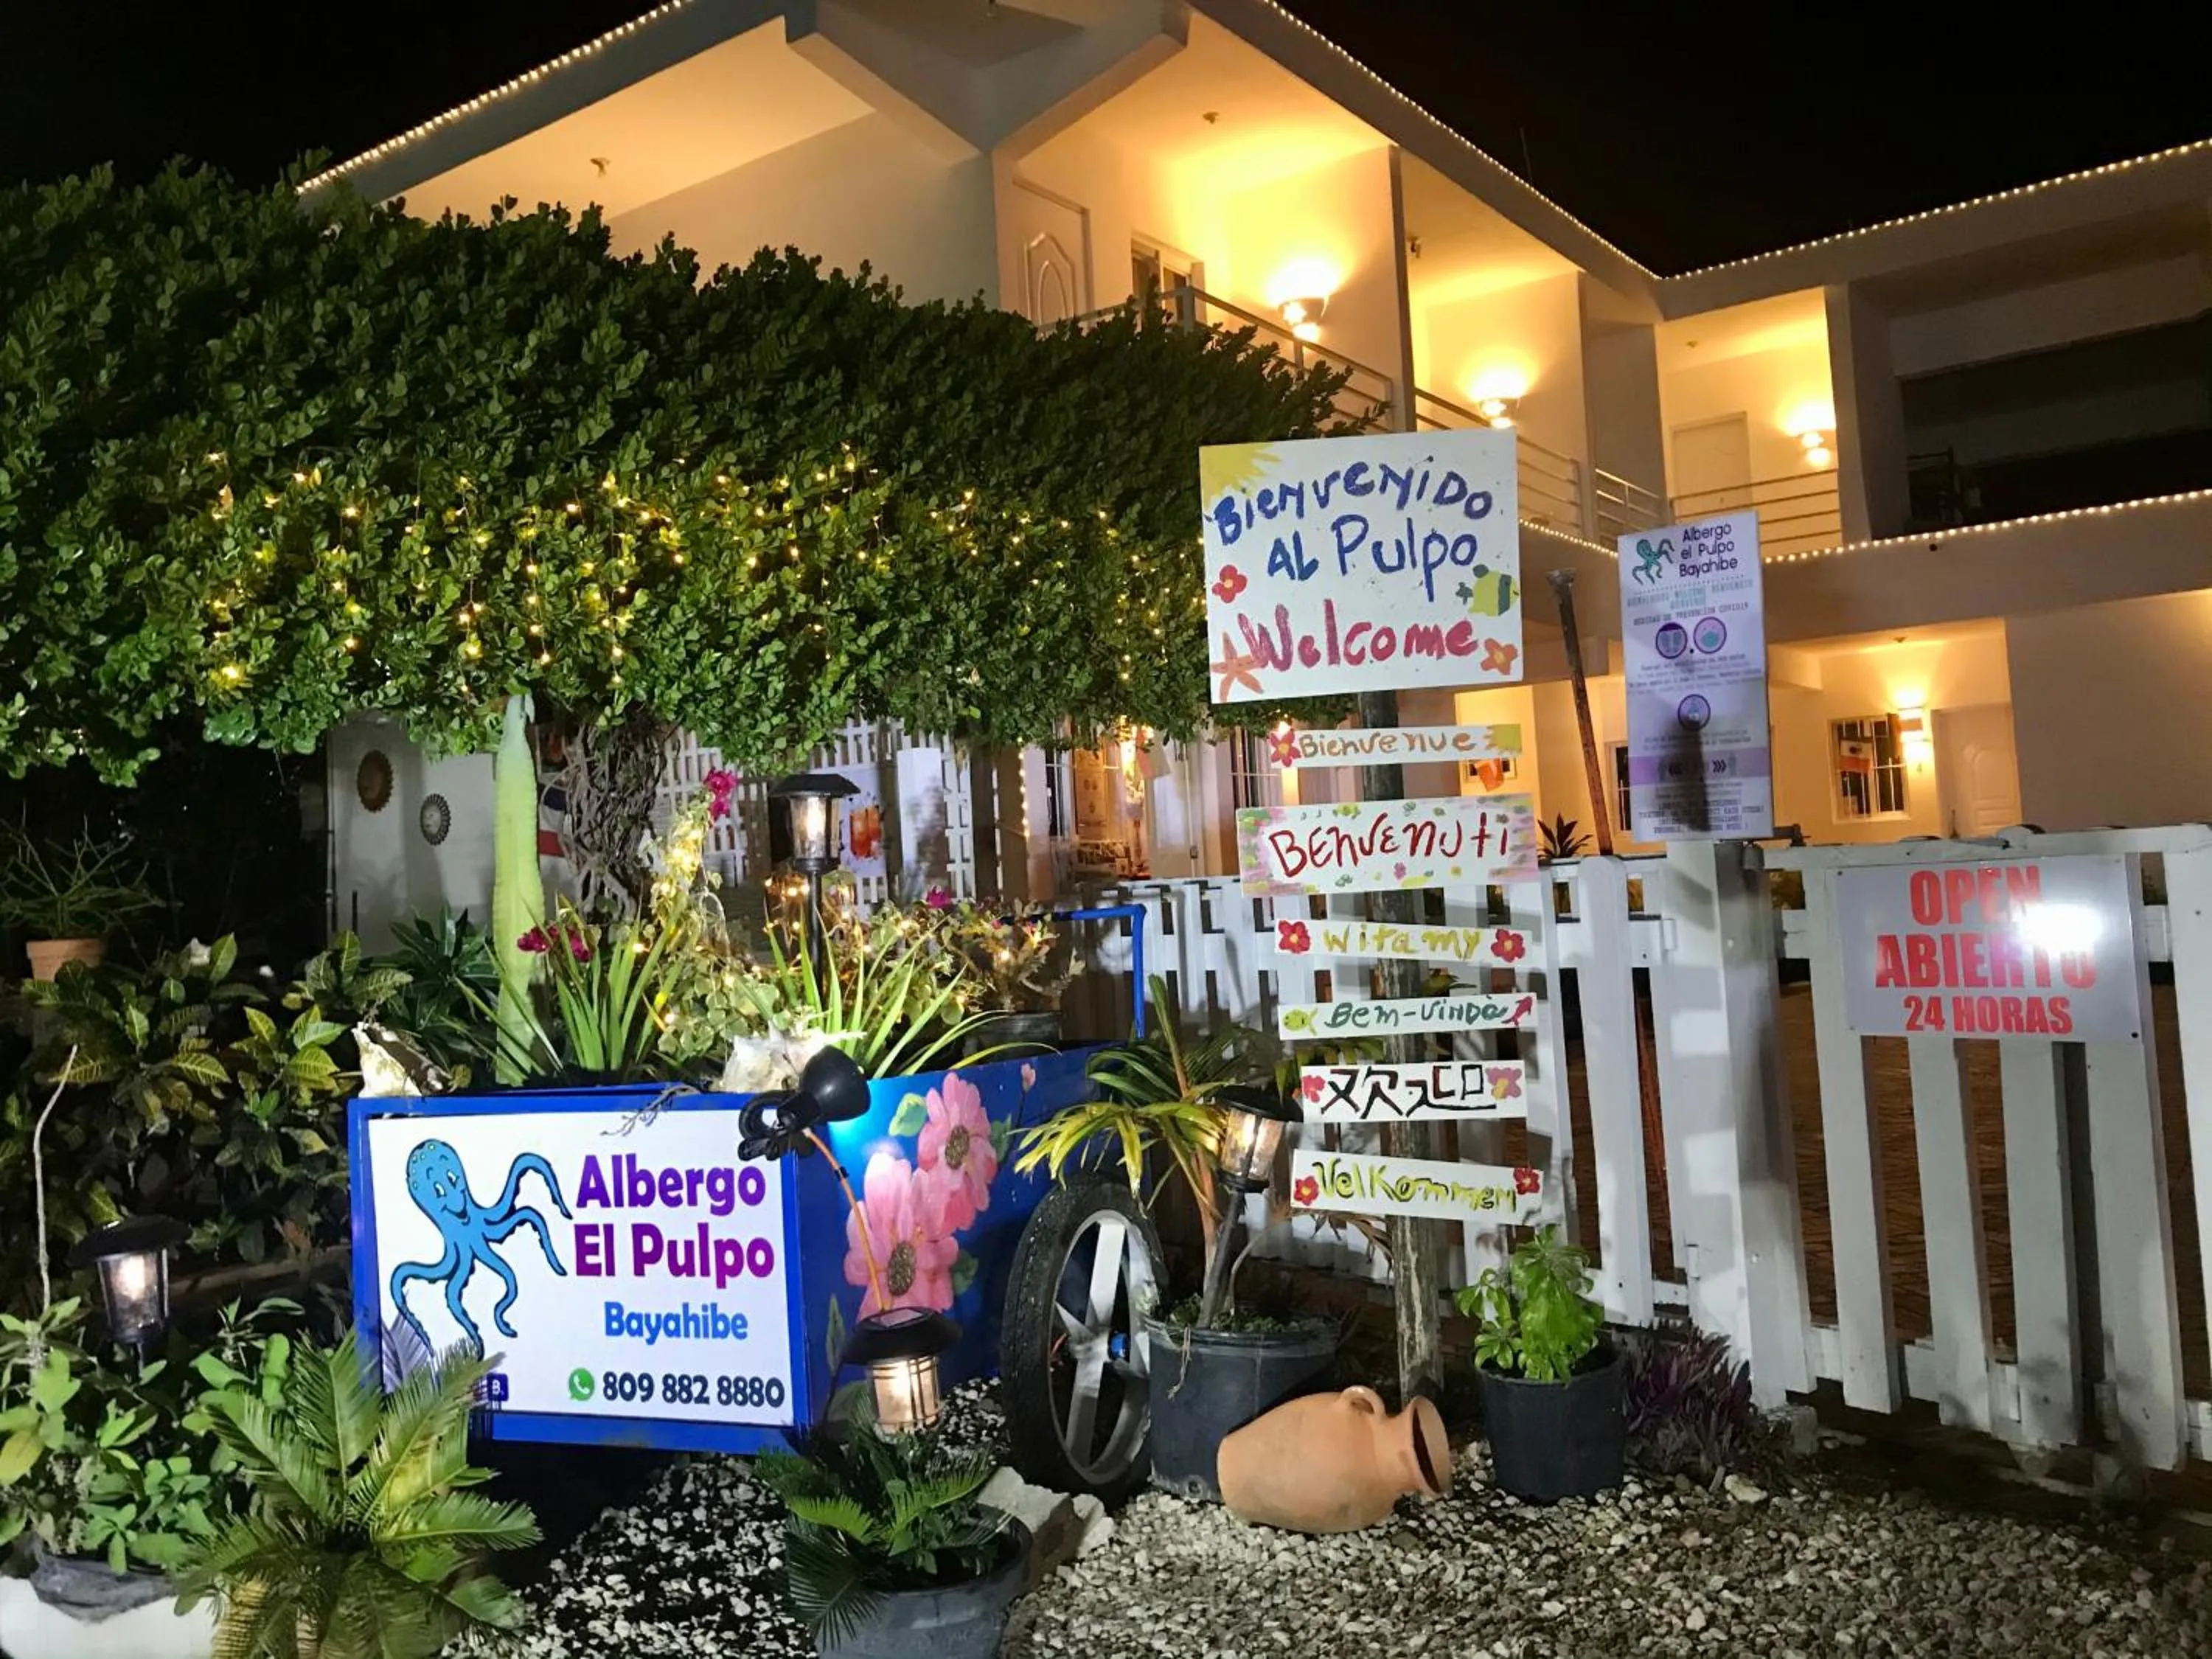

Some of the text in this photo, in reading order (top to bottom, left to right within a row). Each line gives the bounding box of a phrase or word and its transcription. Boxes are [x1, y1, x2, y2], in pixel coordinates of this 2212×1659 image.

[1680, 540, 1735, 560] el Pulpo
[1683, 523, 1732, 543] Albergo
[1330, 514, 1477, 602] Pulpo
[1679, 557, 1739, 578] Bayahibe
[1237, 599, 1478, 672] Welcome
[1298, 731, 1477, 757] Bienvenue
[1910, 865, 2042, 926] OPEN
[1904, 995, 2073, 1034] 24 HORAS
[1321, 1064, 1498, 1120] 欢迎
[576, 1153, 766, 1217] Albergo
[574, 1222, 776, 1289] El Pulpo
[604, 1301, 748, 1345] Bayahibe
[602, 1371, 785, 1408] 809 882 8880
